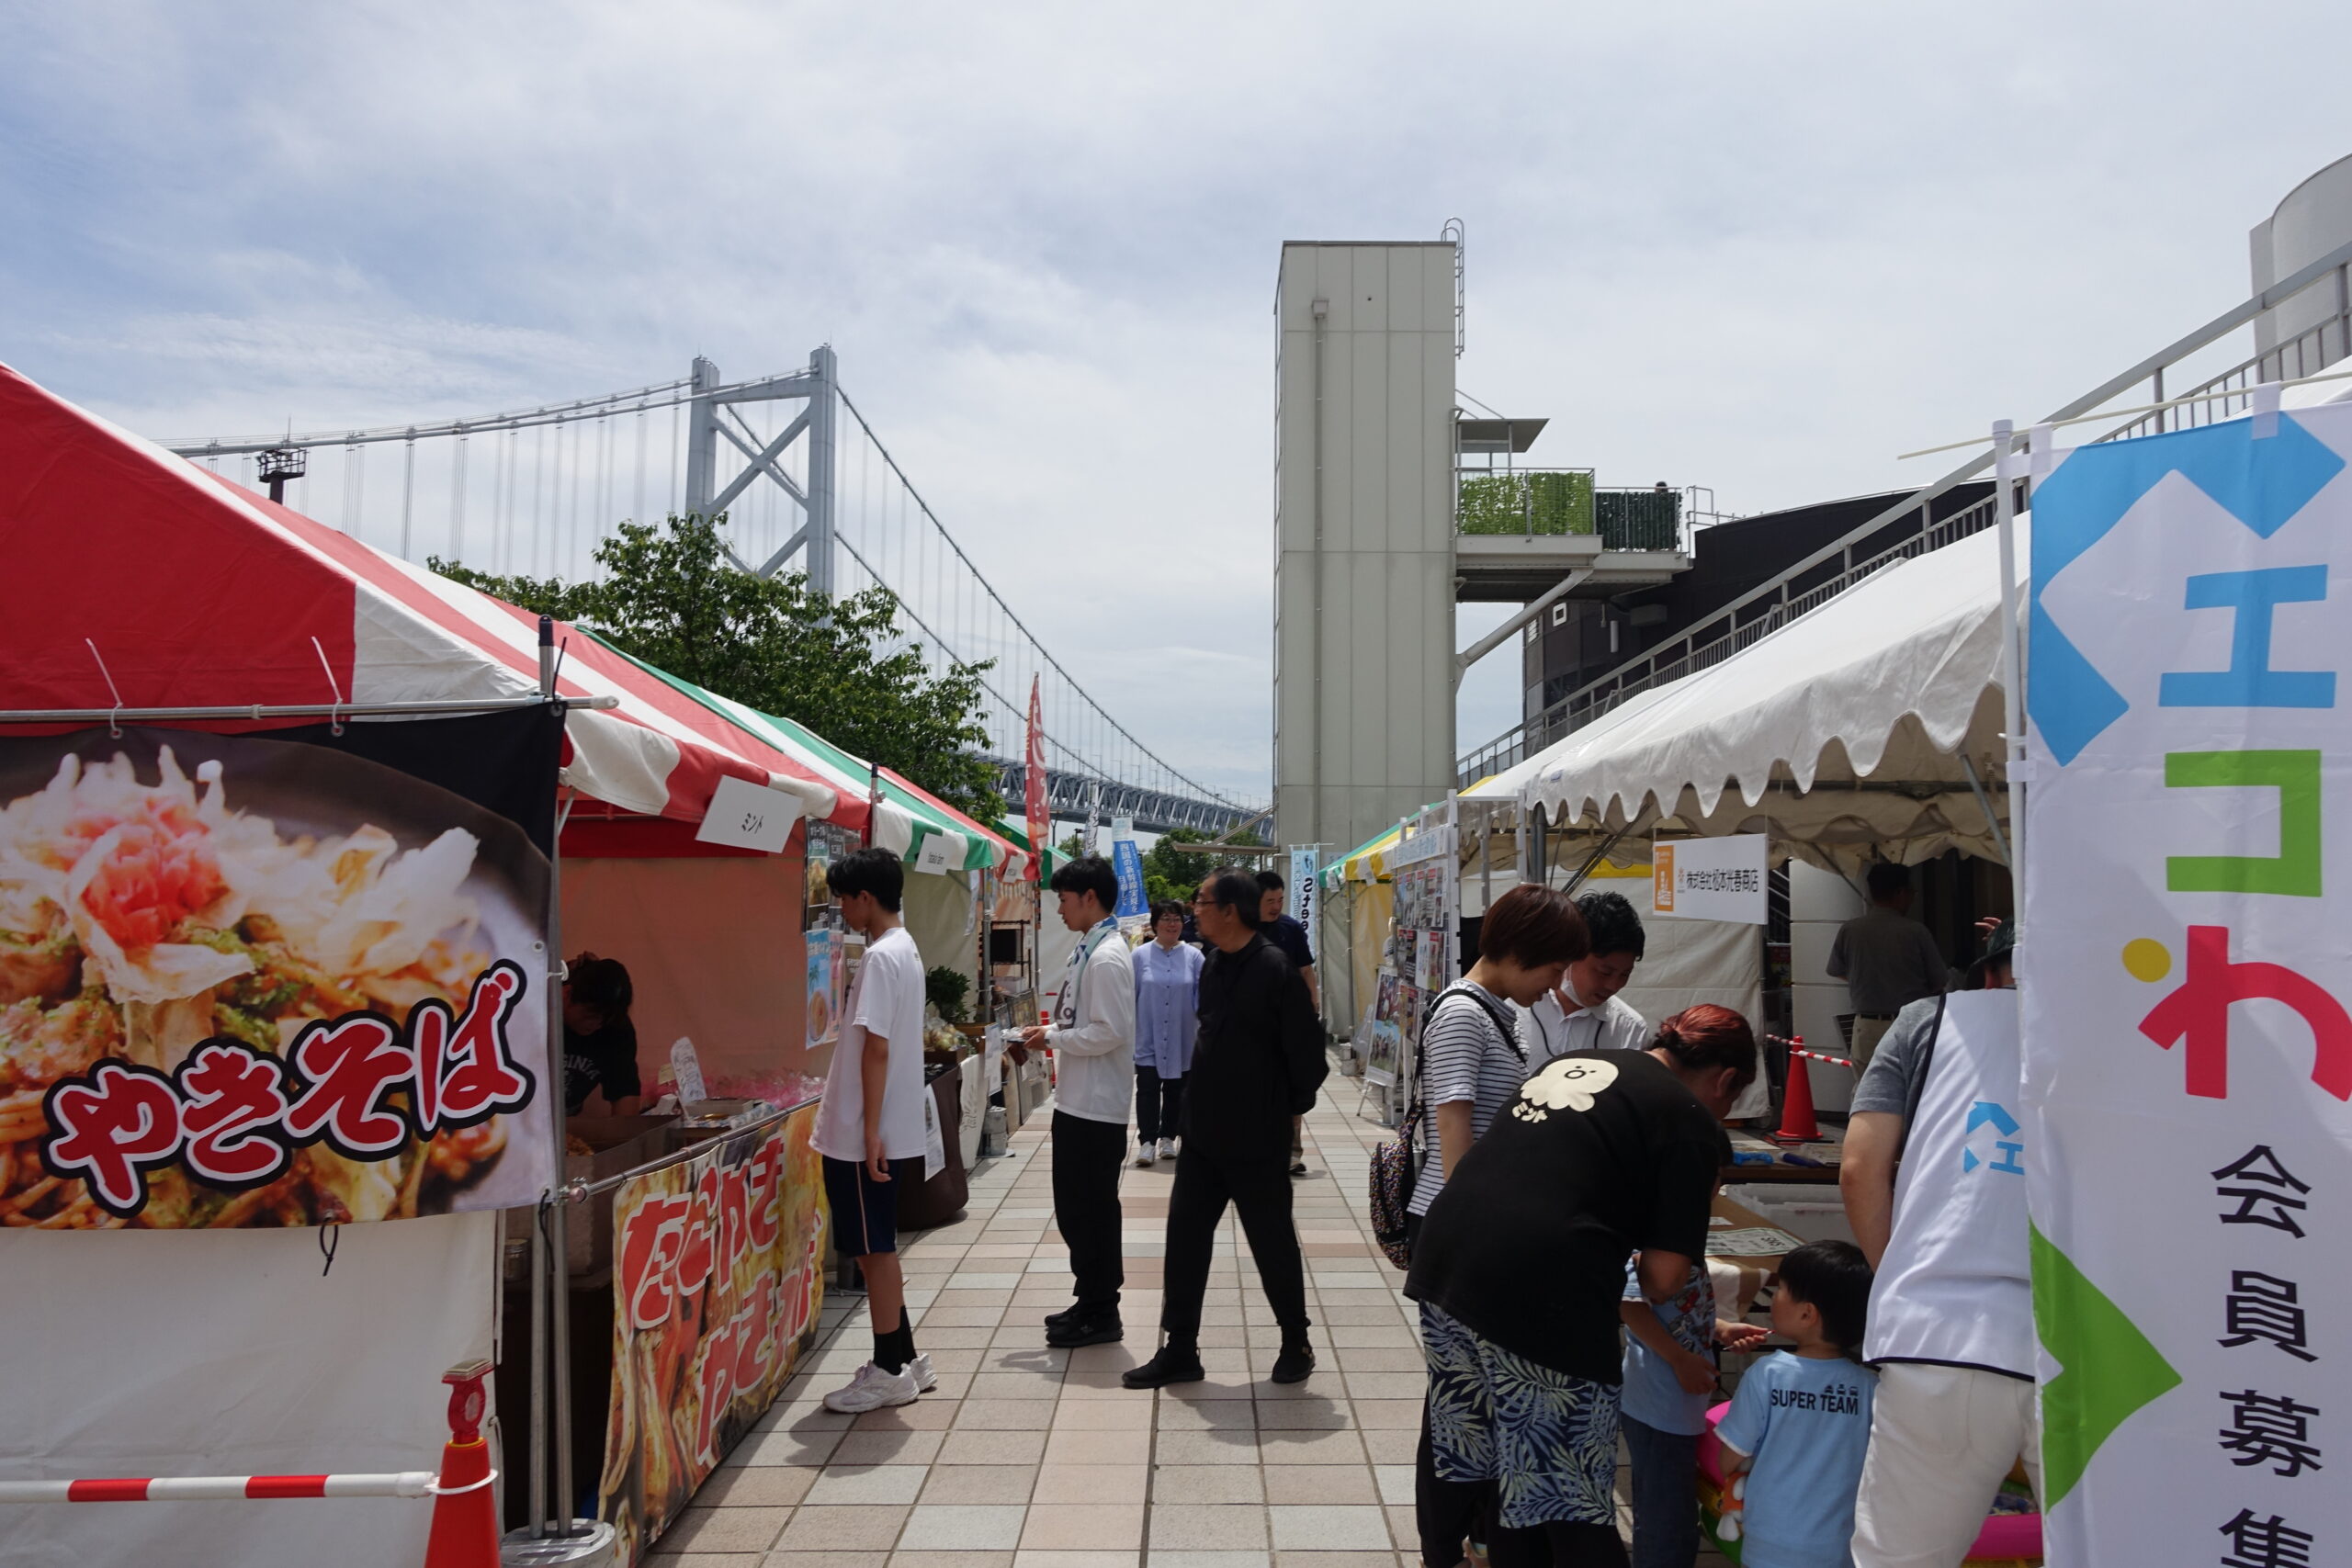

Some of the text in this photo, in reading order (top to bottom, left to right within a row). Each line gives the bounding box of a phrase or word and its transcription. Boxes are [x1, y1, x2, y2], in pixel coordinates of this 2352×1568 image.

[741, 812, 764, 835] ミント
[2138, 563, 2352, 1100] エコわ
[46, 963, 531, 1213] やきそば
[1511, 1101, 1548, 1123] ミント
[621, 1134, 785, 1344] たこやき
[1770, 1387, 1859, 1416] SUPER TEAM
